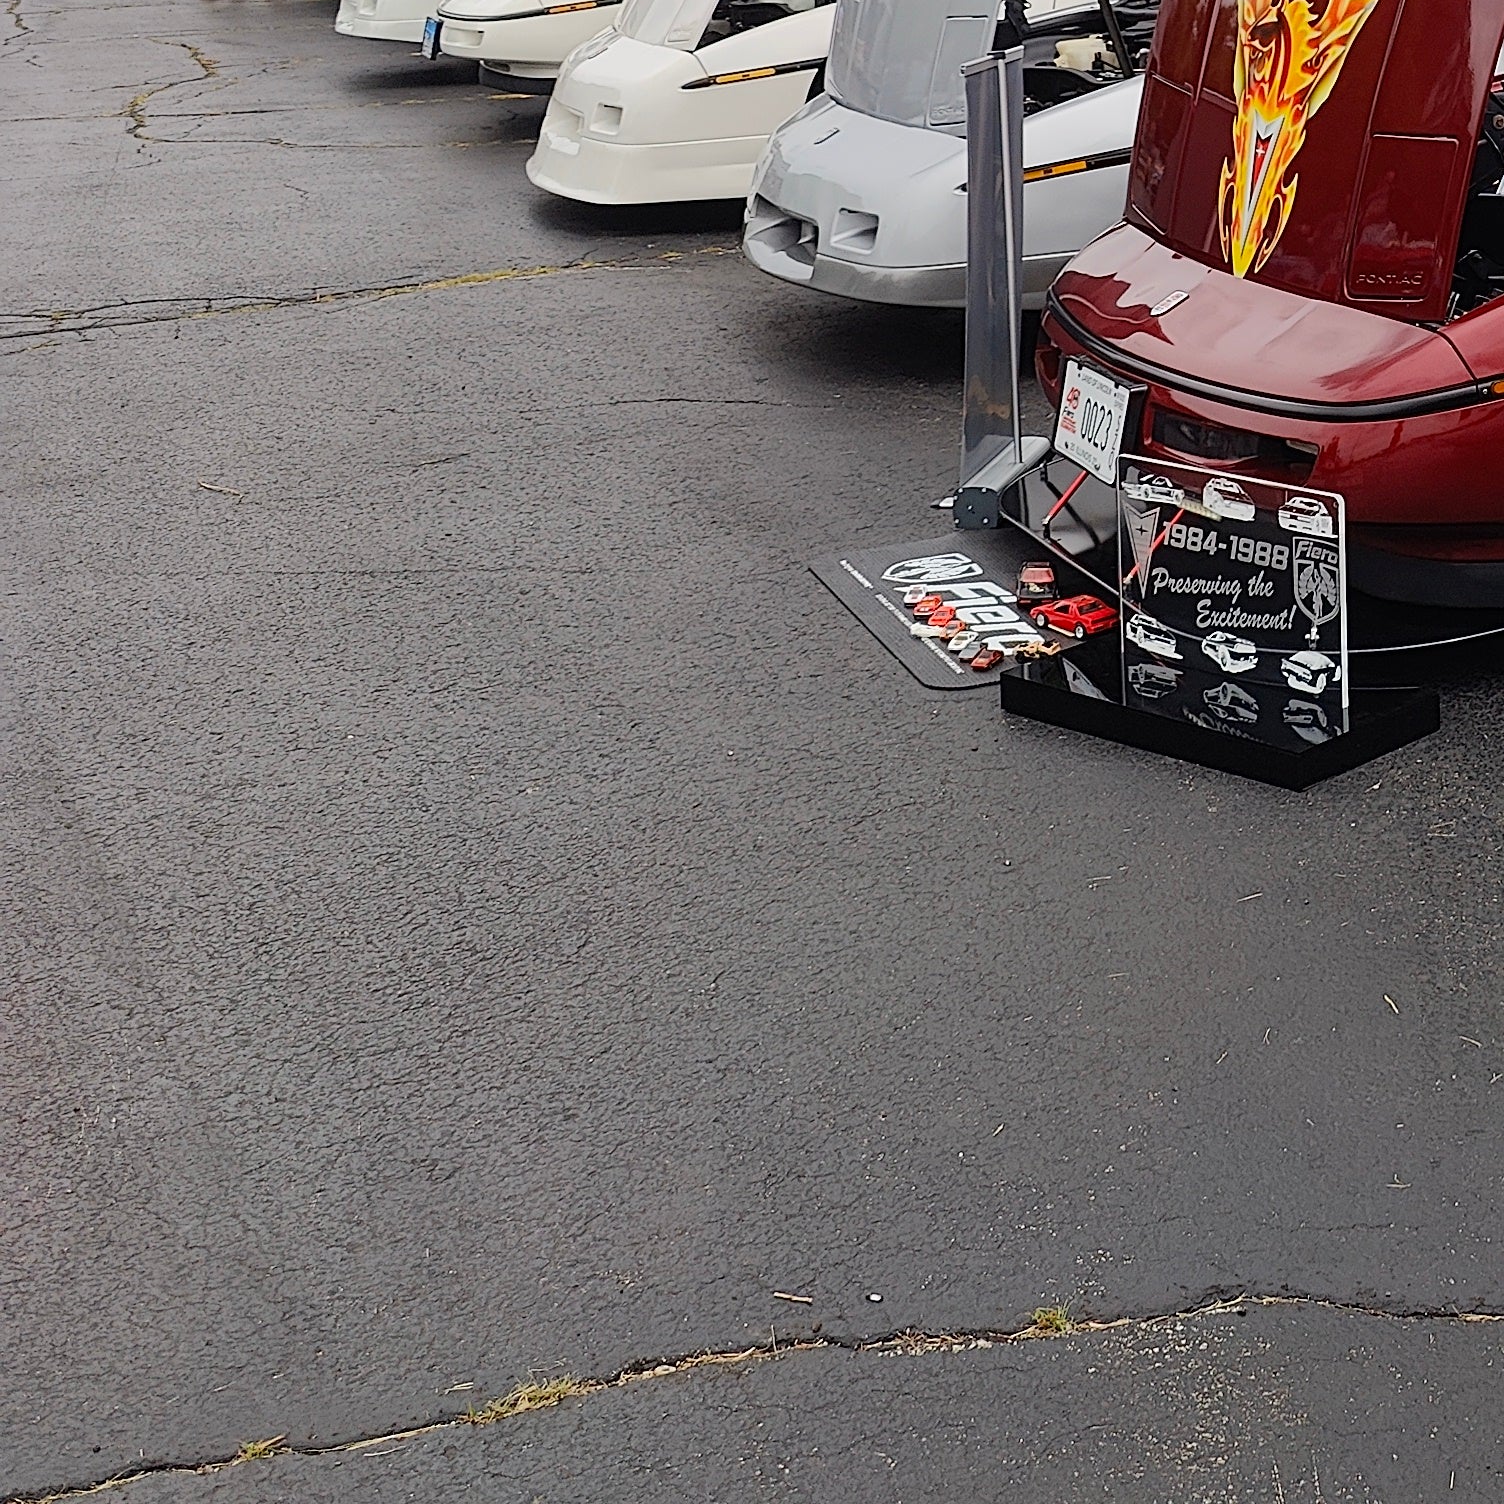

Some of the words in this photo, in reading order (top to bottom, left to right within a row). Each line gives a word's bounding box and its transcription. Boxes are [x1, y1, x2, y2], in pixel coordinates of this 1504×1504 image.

[1355, 271, 1424, 286] PONTIAC
[1080, 397, 1113, 451] 0023
[1162, 521, 1289, 571] 1984-1988
[1295, 540, 1339, 565] Fiero
[1151, 567, 1243, 604] Preserving
[1247, 570, 1275, 597] the
[1195, 599, 1298, 631] Excitement!
